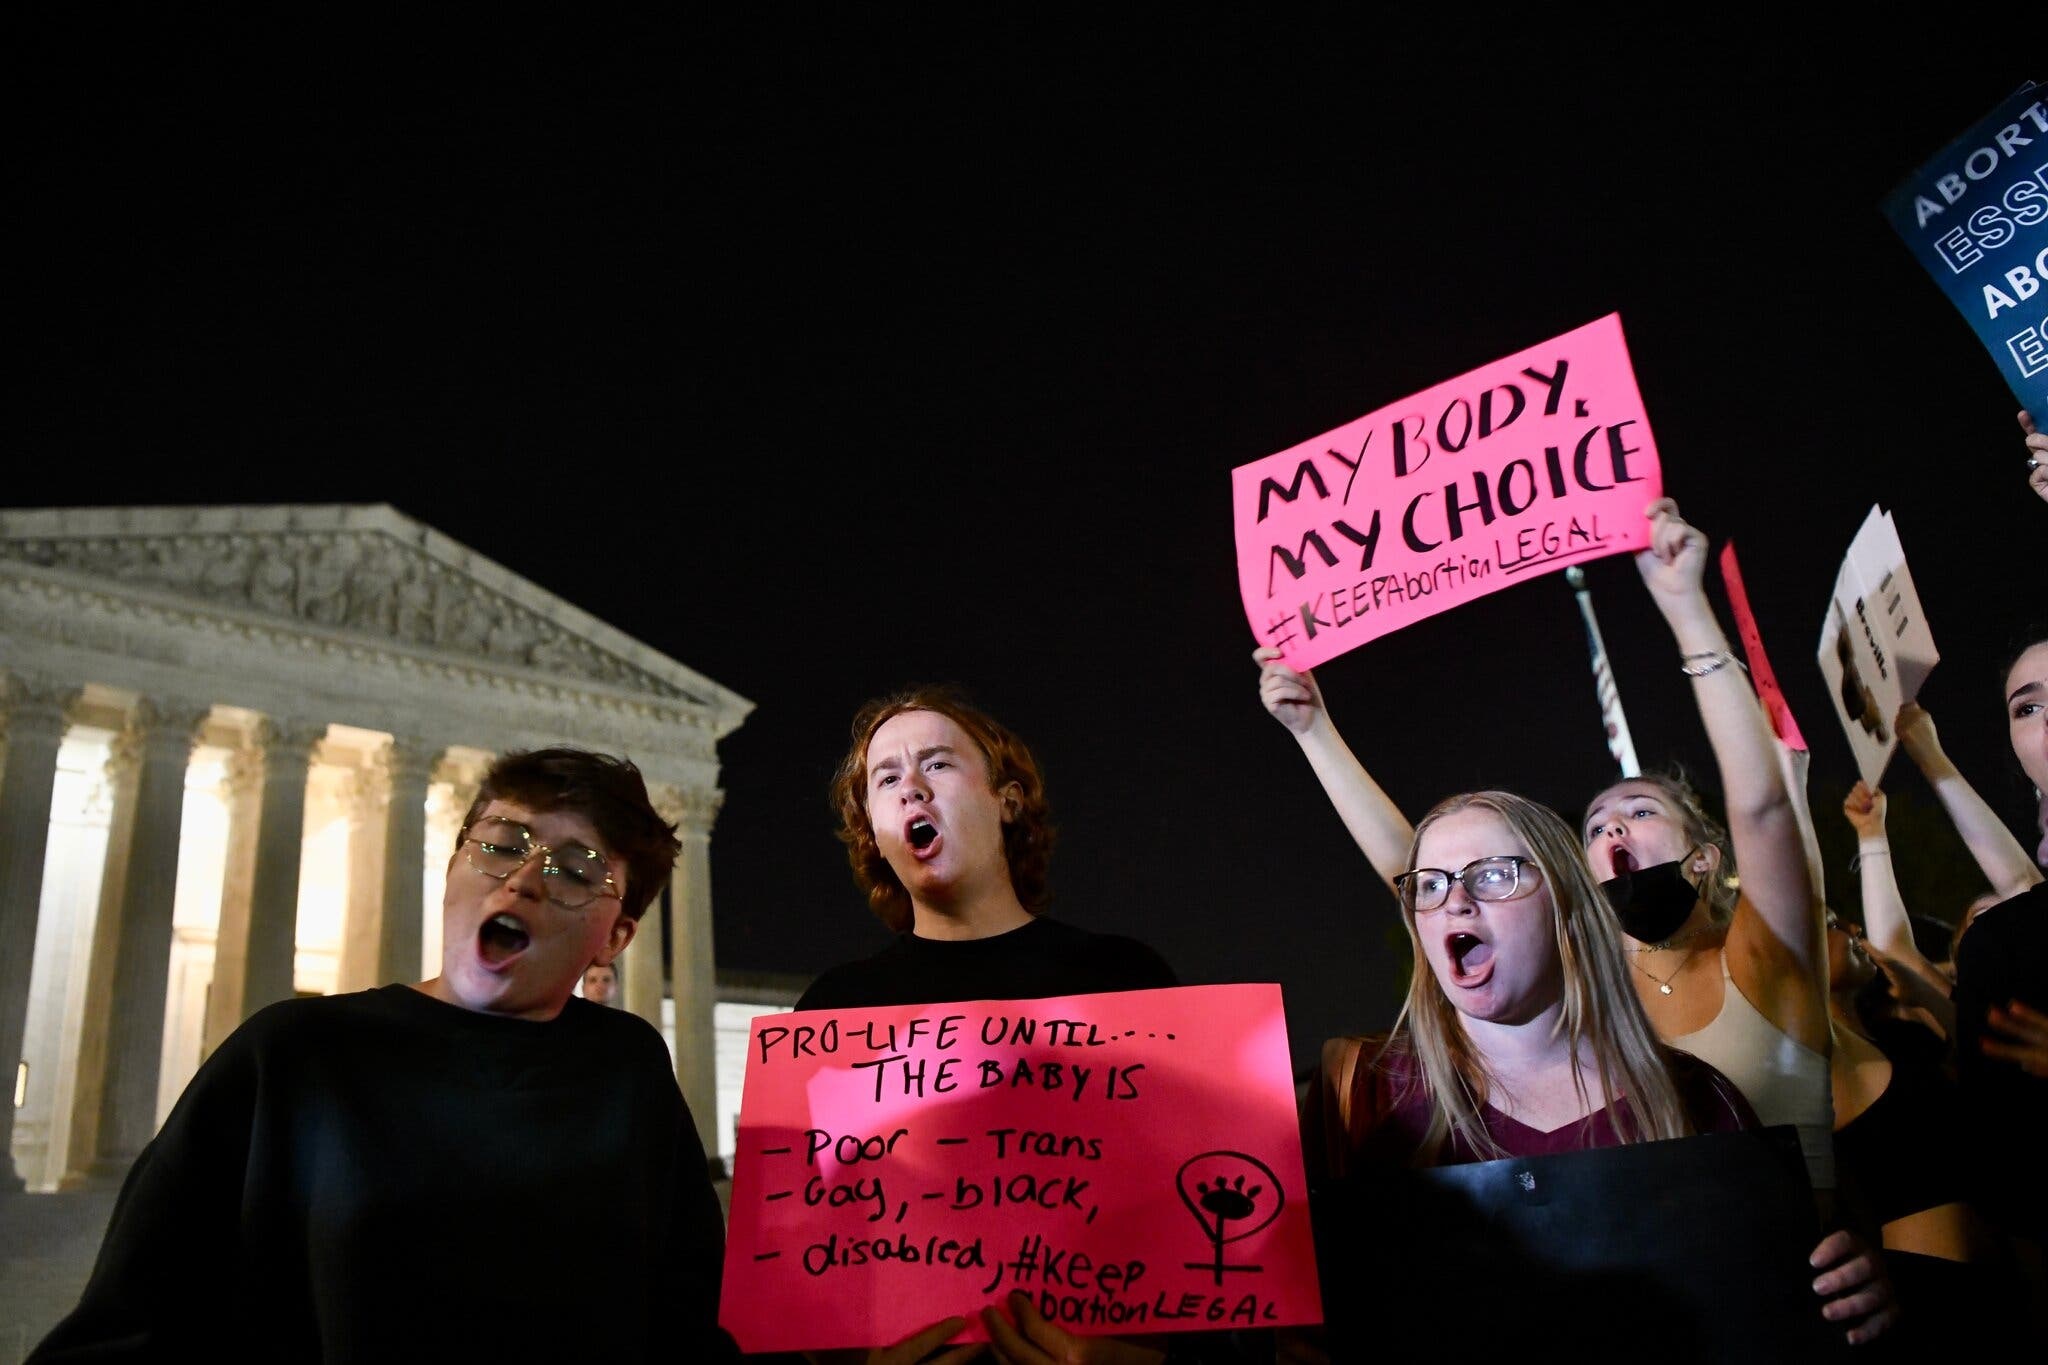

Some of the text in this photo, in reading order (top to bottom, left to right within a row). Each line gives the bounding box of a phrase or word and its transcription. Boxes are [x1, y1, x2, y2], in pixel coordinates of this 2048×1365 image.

[1257, 429, 1373, 525] MY
[1267, 420, 1648, 599] MY CHOICE
[757, 1015, 967, 1064] PRO-LIFE
[851, 1054, 1146, 1103] THE BABY IS
[804, 1128, 908, 1166] Poor
[1153, 1291, 1279, 1323] LEGAL
